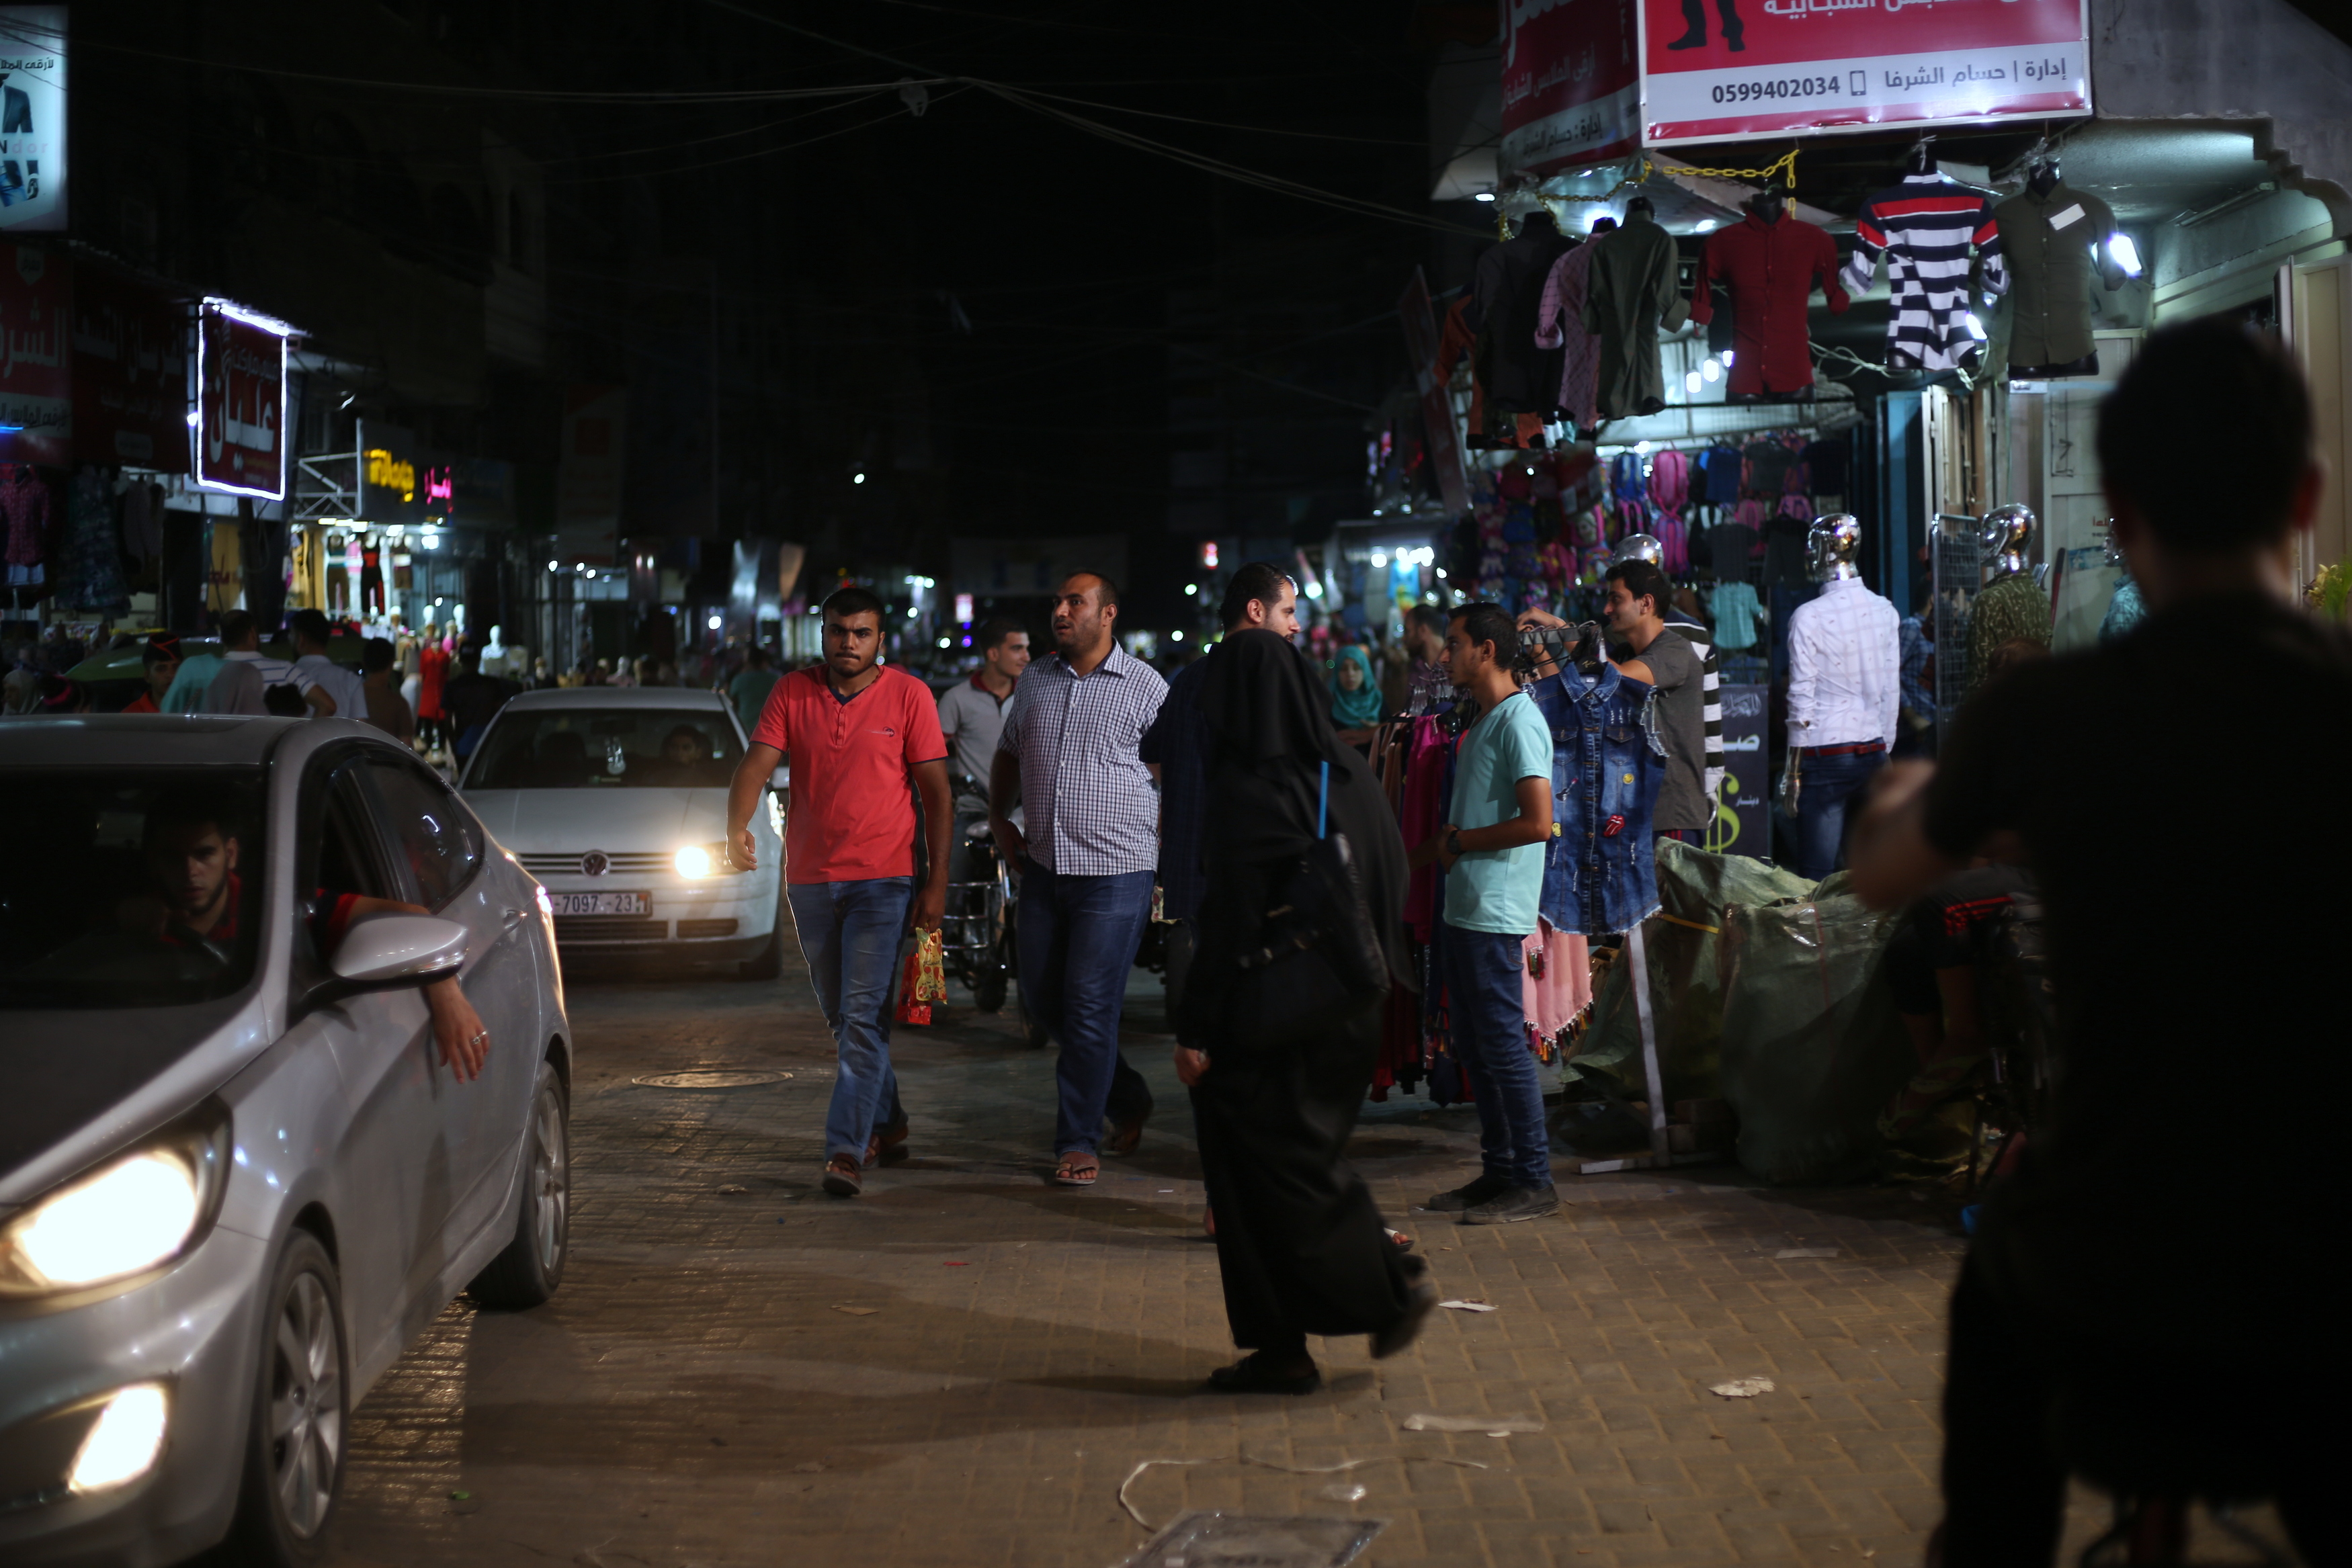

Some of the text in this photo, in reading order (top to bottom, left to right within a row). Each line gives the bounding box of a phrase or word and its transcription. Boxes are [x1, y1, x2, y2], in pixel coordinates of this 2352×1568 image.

[1885, 67, 1944, 91] الشرفا
[1952, 65, 2005, 87] حسام
[2025, 58, 2066, 81] إدارة
[1712, 76, 1840, 103] 0599402034
[1581, 113, 1603, 141] إدارة
[210, 370, 274, 471] عليان
